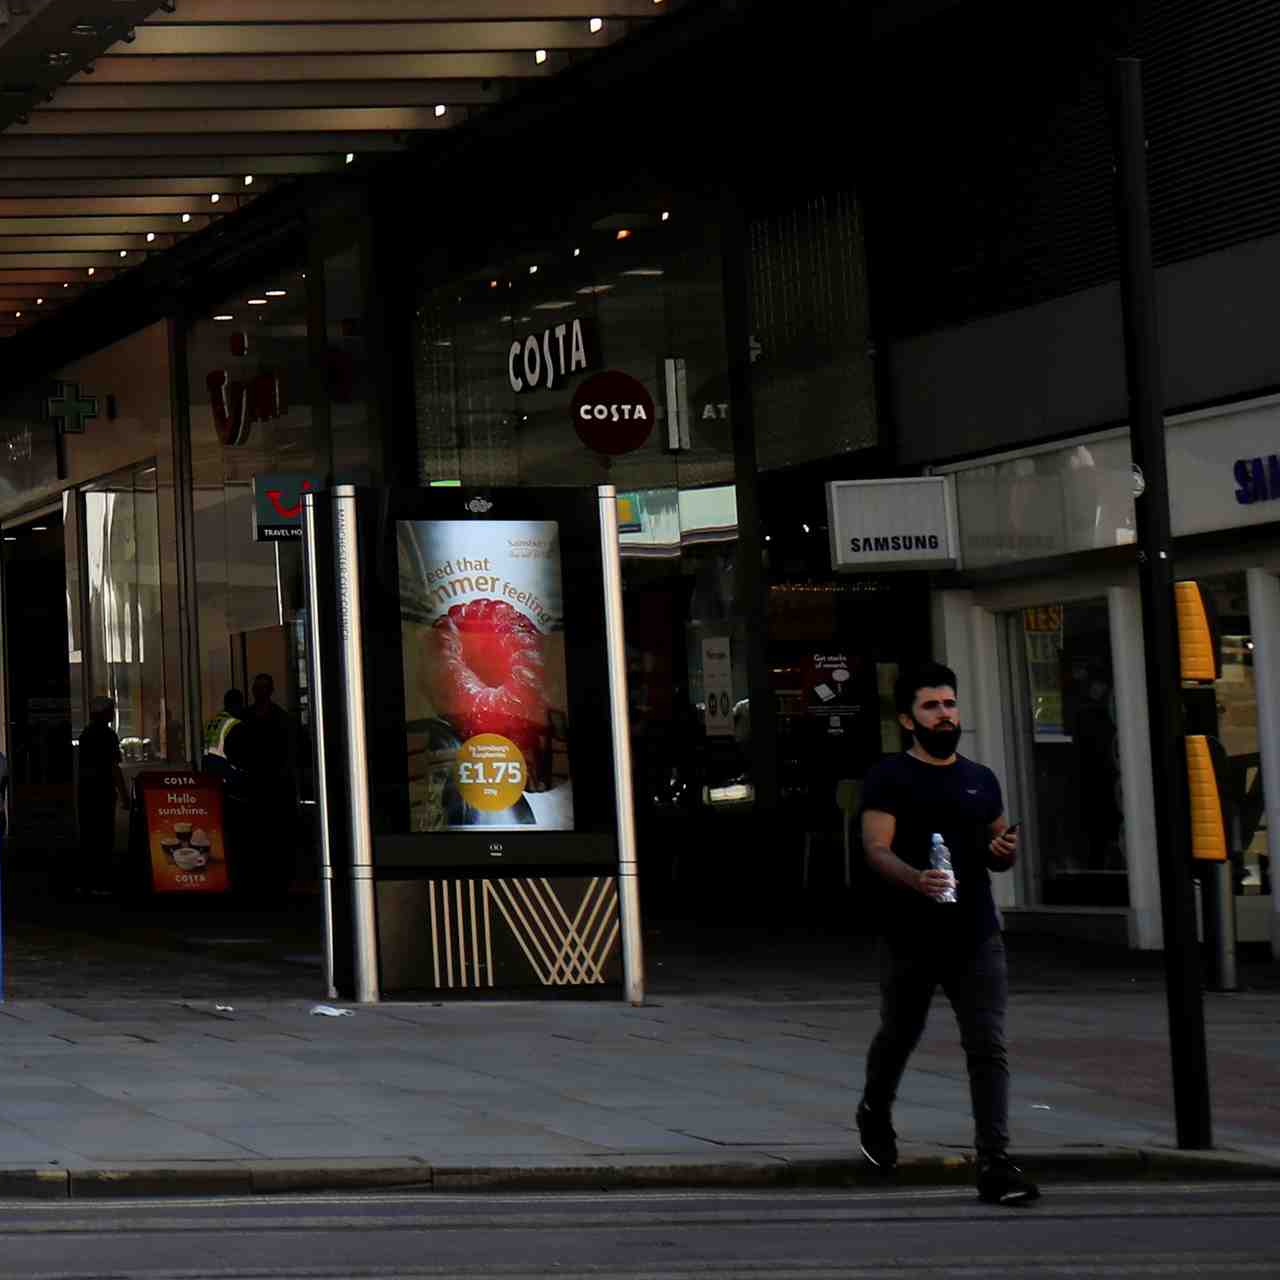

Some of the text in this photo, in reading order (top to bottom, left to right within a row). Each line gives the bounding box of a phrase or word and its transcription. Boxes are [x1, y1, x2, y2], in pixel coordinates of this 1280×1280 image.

[508, 318, 587, 393] COSTA
[579, 404, 648, 422] COSTA
[291, 528, 303, 536] HO
[850, 535, 938, 553] SAMSUNG
[425, 557, 490, 582] eed that
[502, 582, 551, 626] feeling
[163, 776, 197, 785] COSTA
[458, 762, 522, 784] £1.75
[167, 793, 198, 803] Hello
[158, 805, 208, 816] sunshine.
[175, 872, 207, 882] COSTA
